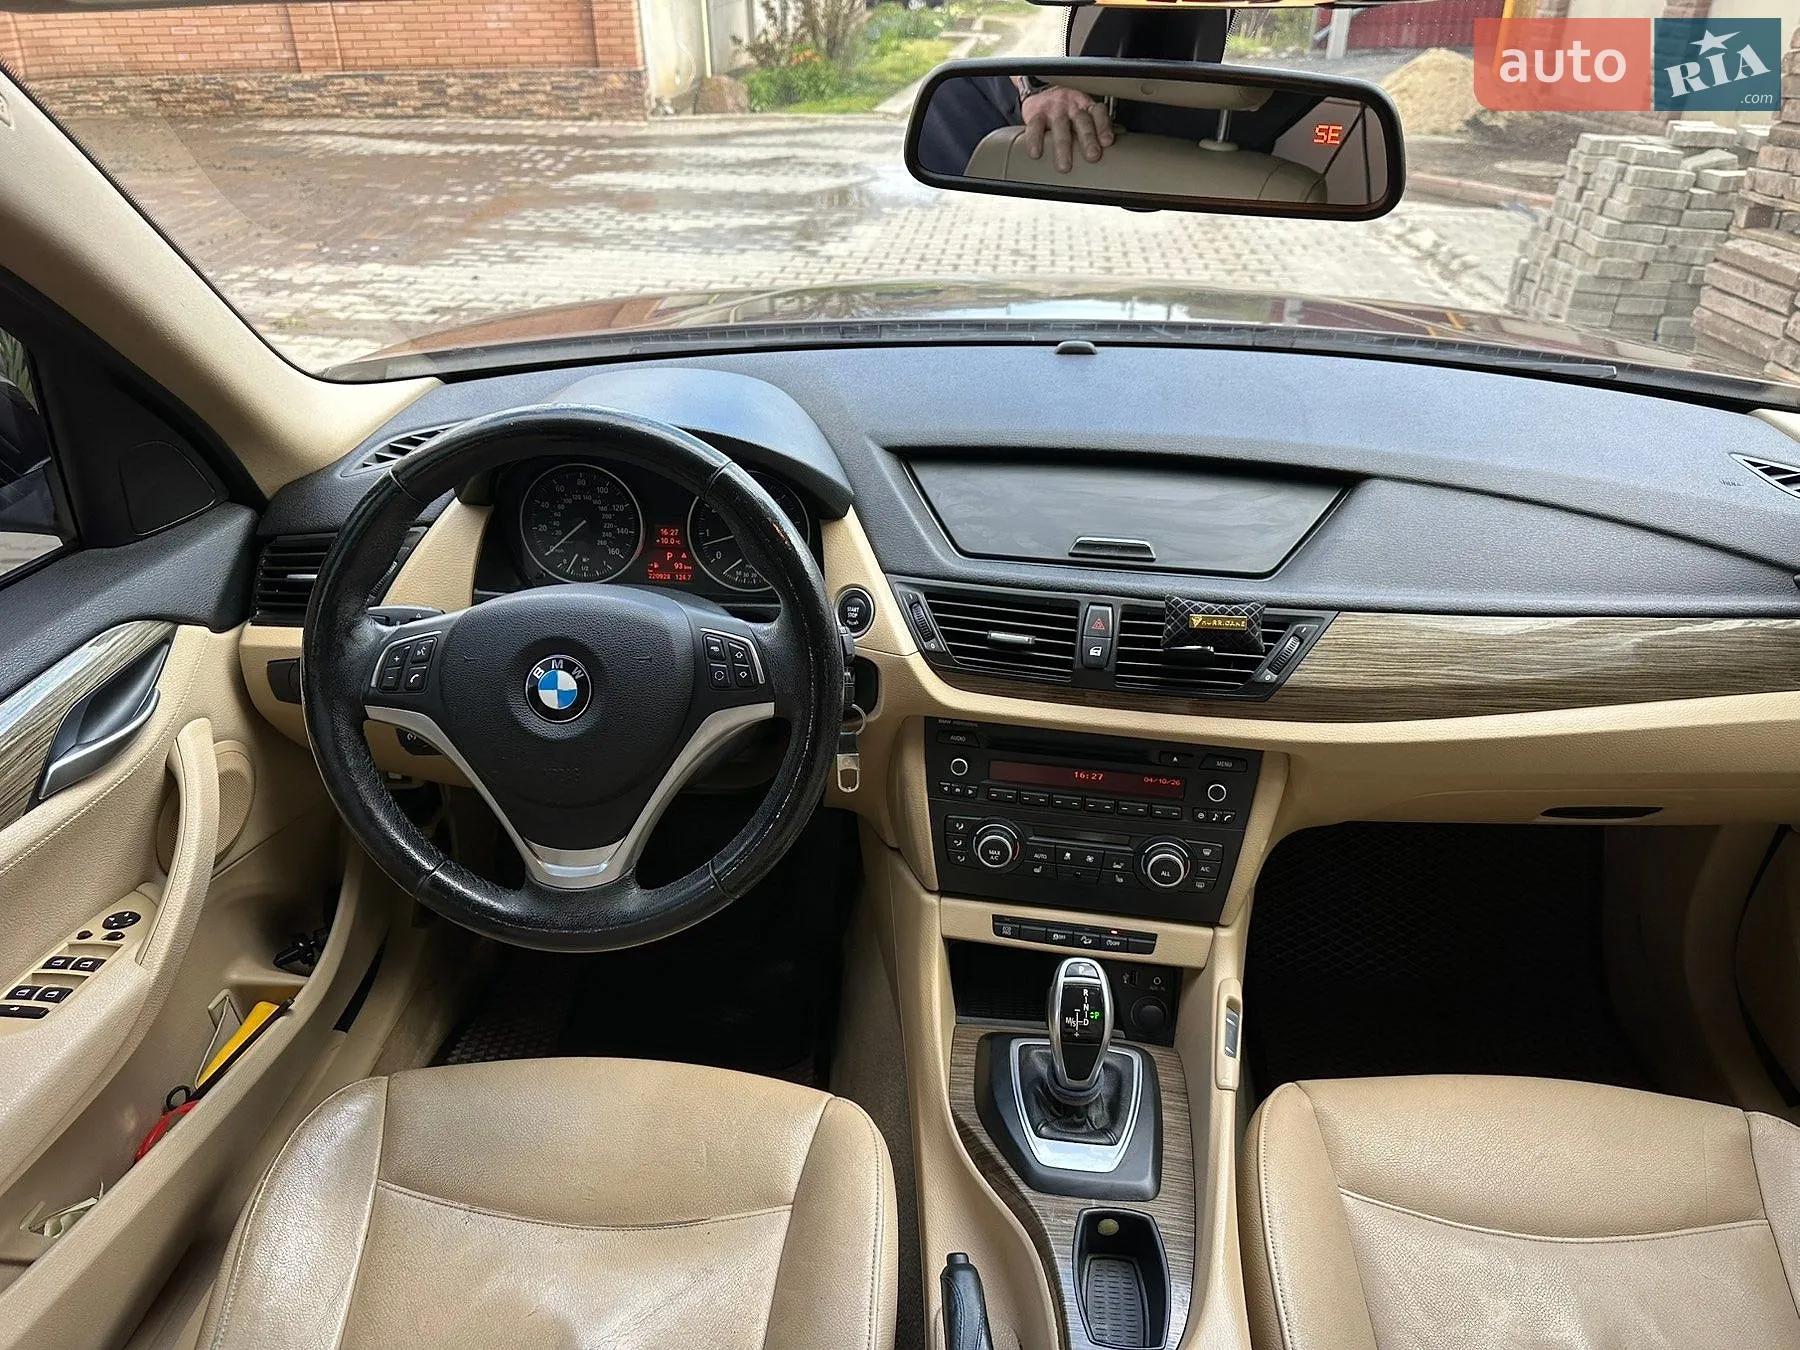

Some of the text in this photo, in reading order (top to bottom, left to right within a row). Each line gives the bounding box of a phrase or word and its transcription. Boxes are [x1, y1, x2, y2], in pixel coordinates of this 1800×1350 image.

[1313, 124, 1343, 145] SE
[612, 504, 625, 512] 120
[538, 524, 548, 532] 20
[616, 527, 629, 535] 140
[607, 547, 620, 555] 160
[666, 552, 674, 560] P
[533, 659, 585, 680] BMW
[950, 735, 967, 743] AUDIO
[1216, 760, 1233, 768] MENU
[1074, 771, 1181, 786] 16:27 04/10/26
[1078, 965, 1085, 974] P
[1083, 988, 1089, 997] R
[1083, 1003, 1090, 1012] N
[1094, 1011, 1100, 1019] P
[1083, 1018, 1090, 1026] D
